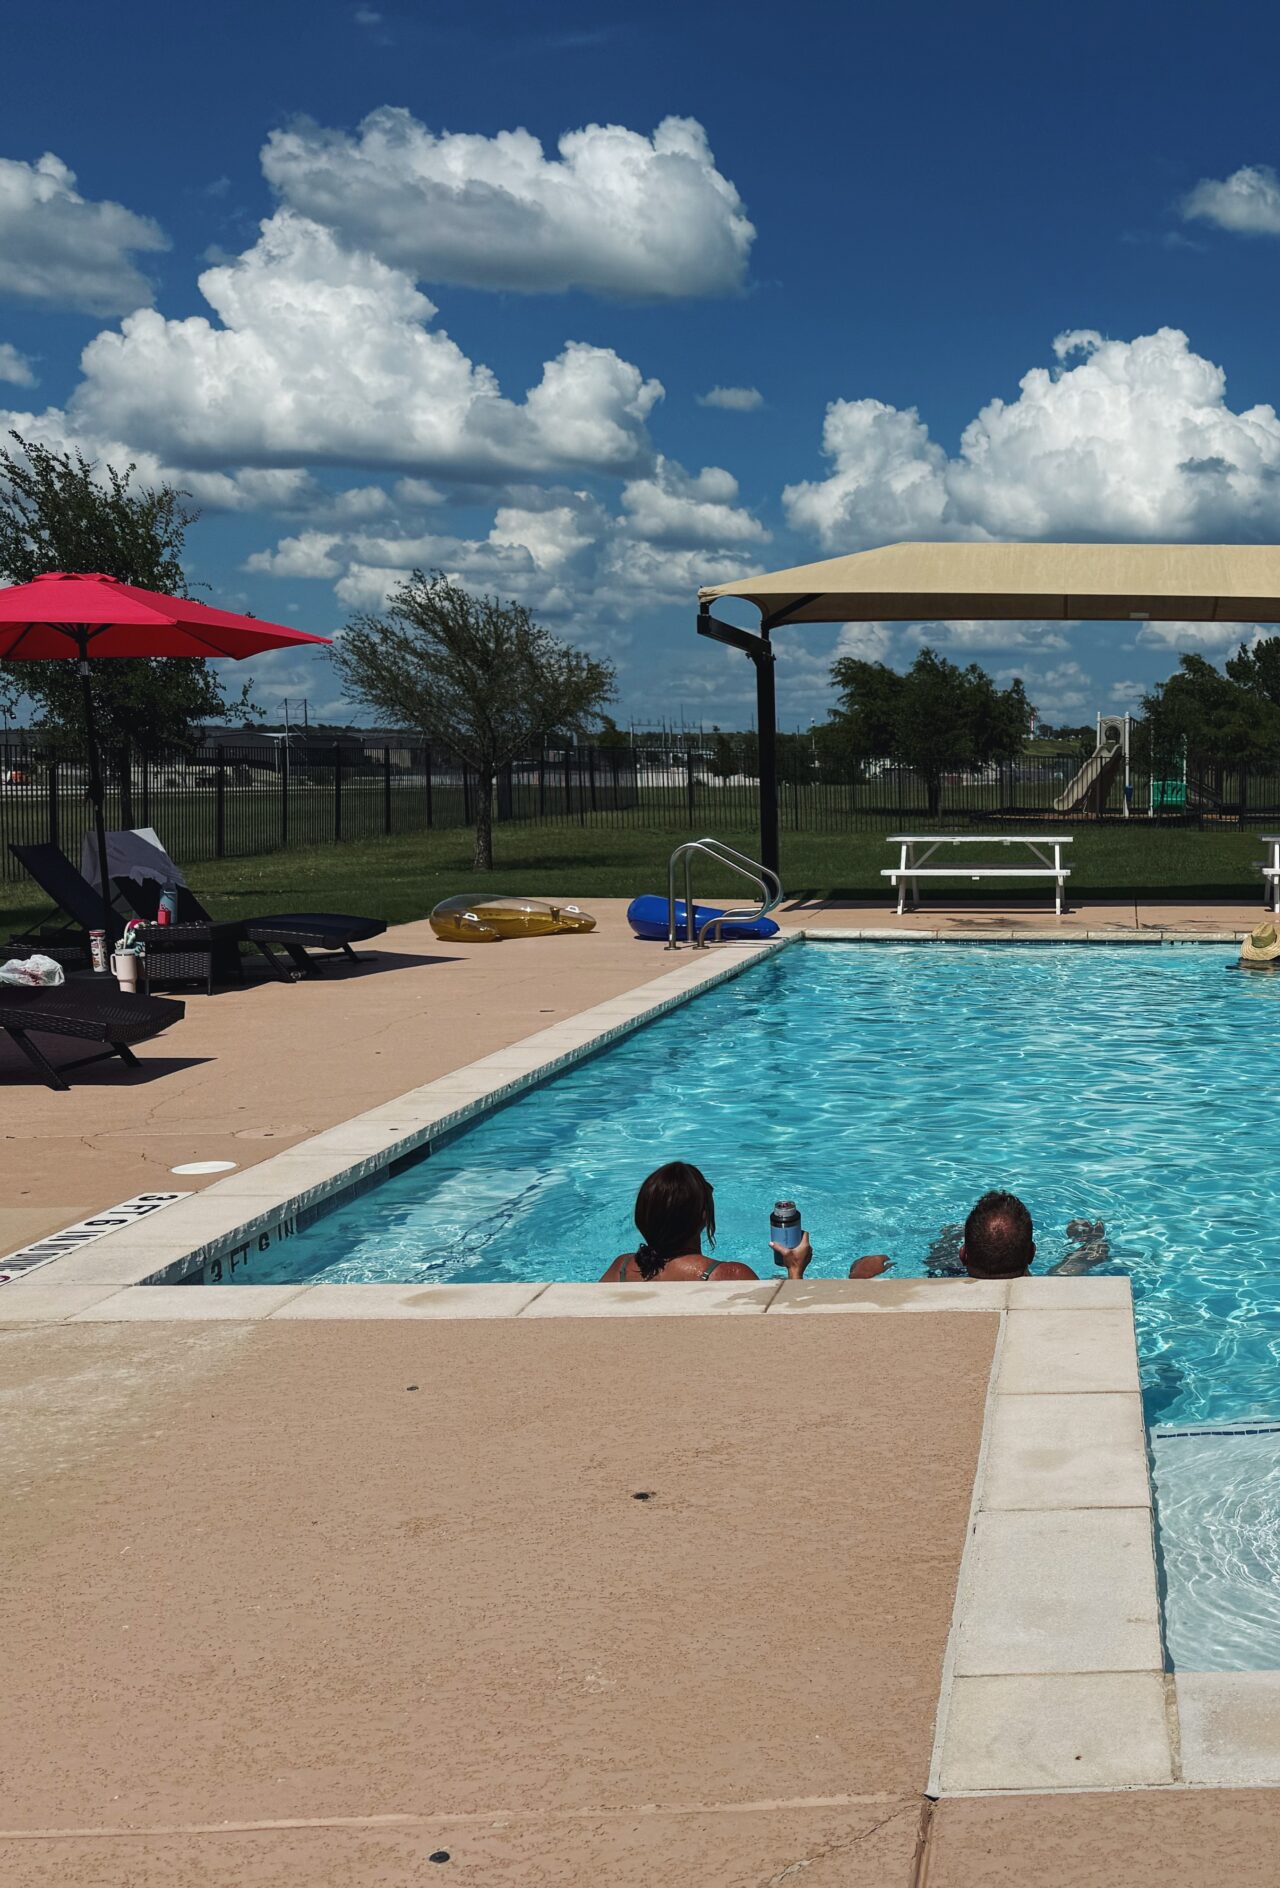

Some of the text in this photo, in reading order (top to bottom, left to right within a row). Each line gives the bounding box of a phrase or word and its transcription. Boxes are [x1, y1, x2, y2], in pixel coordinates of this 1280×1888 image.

[138, 1194, 179, 1202] 3
[108, 1204, 162, 1216] FT
[84, 1219, 129, 1227] 6
[48, 1230, 107, 1242] IN
[210, 1258, 223, 1283] 3
[230, 1240, 251, 1273] FT
[277, 1217, 295, 1241] IN
